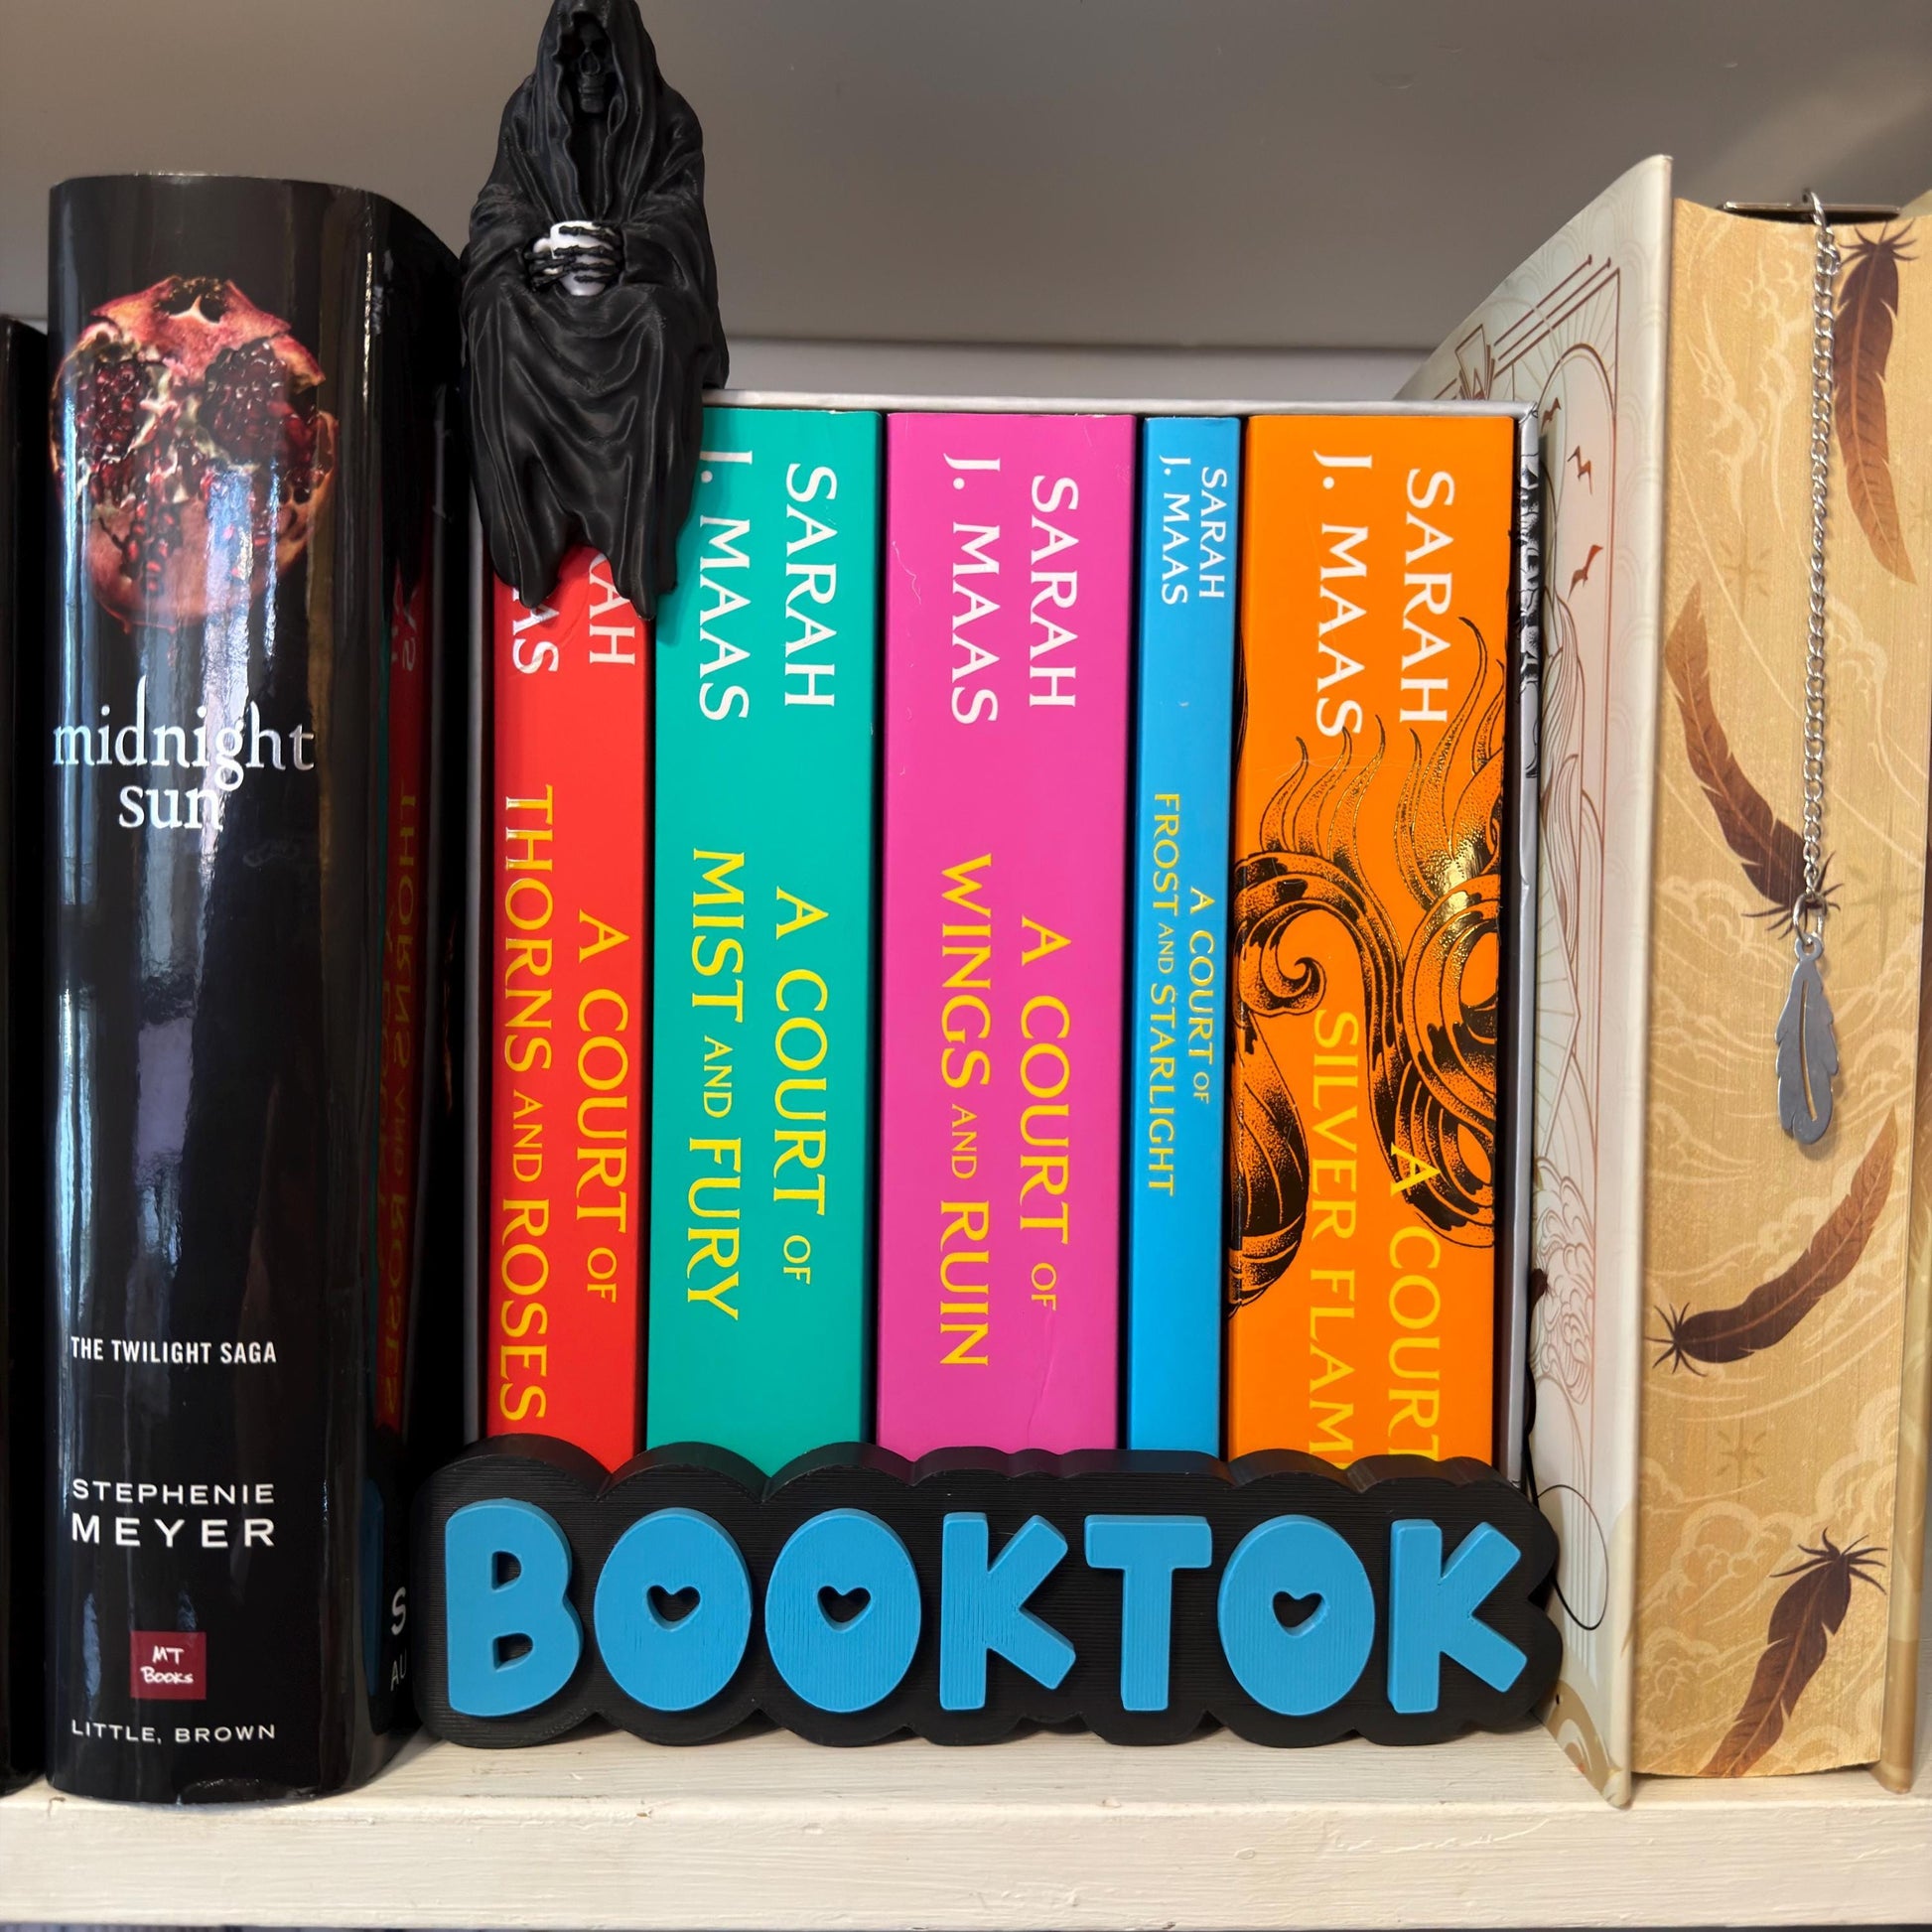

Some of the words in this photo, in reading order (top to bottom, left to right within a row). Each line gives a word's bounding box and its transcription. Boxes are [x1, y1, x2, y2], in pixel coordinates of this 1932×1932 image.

[943, 453, 1002, 490] J.
[1159, 455, 1191, 477] J.
[1312, 449, 1373, 490] J.
[784, 463, 838, 708] SARAH
[1161, 491, 1191, 606] MAAS
[1198, 467, 1228, 600] SARAH
[588, 552, 636, 666] AH
[698, 514, 752, 722] MAAS
[950, 521, 1001, 725] MAAS
[1029, 475, 1080, 708] SARAH
[1314, 523, 1370, 739] MAAS
[1399, 468, 1455, 725] SARAH
[52, 675, 316, 791] midnight
[118, 783, 224, 831] sun
[1152, 792, 1180, 918] FROST
[504, 784, 554, 1073] THORNS
[578, 909, 630, 964] A
[691, 848, 746, 1024] MIST
[775, 886, 829, 940] A
[1021, 915, 1072, 967] A
[1157, 921, 1175, 975] AND
[1189, 887, 1216, 915] A
[939, 853, 993, 1089] WINGS
[1186, 929, 1215, 1067] COURT
[576, 988, 628, 1234] COURT
[702, 1035, 734, 1119] AND
[772, 969, 828, 1216] COURT
[1019, 995, 1071, 1245] COURT
[1147, 983, 1178, 1197] STARLIGHT
[1193, 1074, 1210, 1105] OF
[1310, 1007, 1360, 1241] SILVER
[511, 1089, 544, 1182] AND
[950, 1103, 979, 1180] AND
[1389, 1142, 1442, 1199] A
[586, 1247, 618, 1304] OF
[686, 1137, 743, 1321] FURY
[782, 1234, 812, 1286] OF
[939, 1200, 991, 1367] RUIN
[1030, 1262, 1057, 1311] OF
[70, 1336, 104, 1362] THE
[111, 1339, 212, 1365] TWILIGHT
[220, 1341, 277, 1364] SAGA
[499, 1199, 550, 1422] ROSES
[1308, 1267, 1357, 1471] FLAM
[71, 1513, 275, 1549] MEYER
[72, 1478, 275, 1505] STEPHENIE
[151, 1645, 185, 1665] MT
[444, 1497, 1530, 1719] BOOKTOK
[71, 1719, 163, 1745] LITTLE,
[175, 1724, 276, 1743] BROWN
